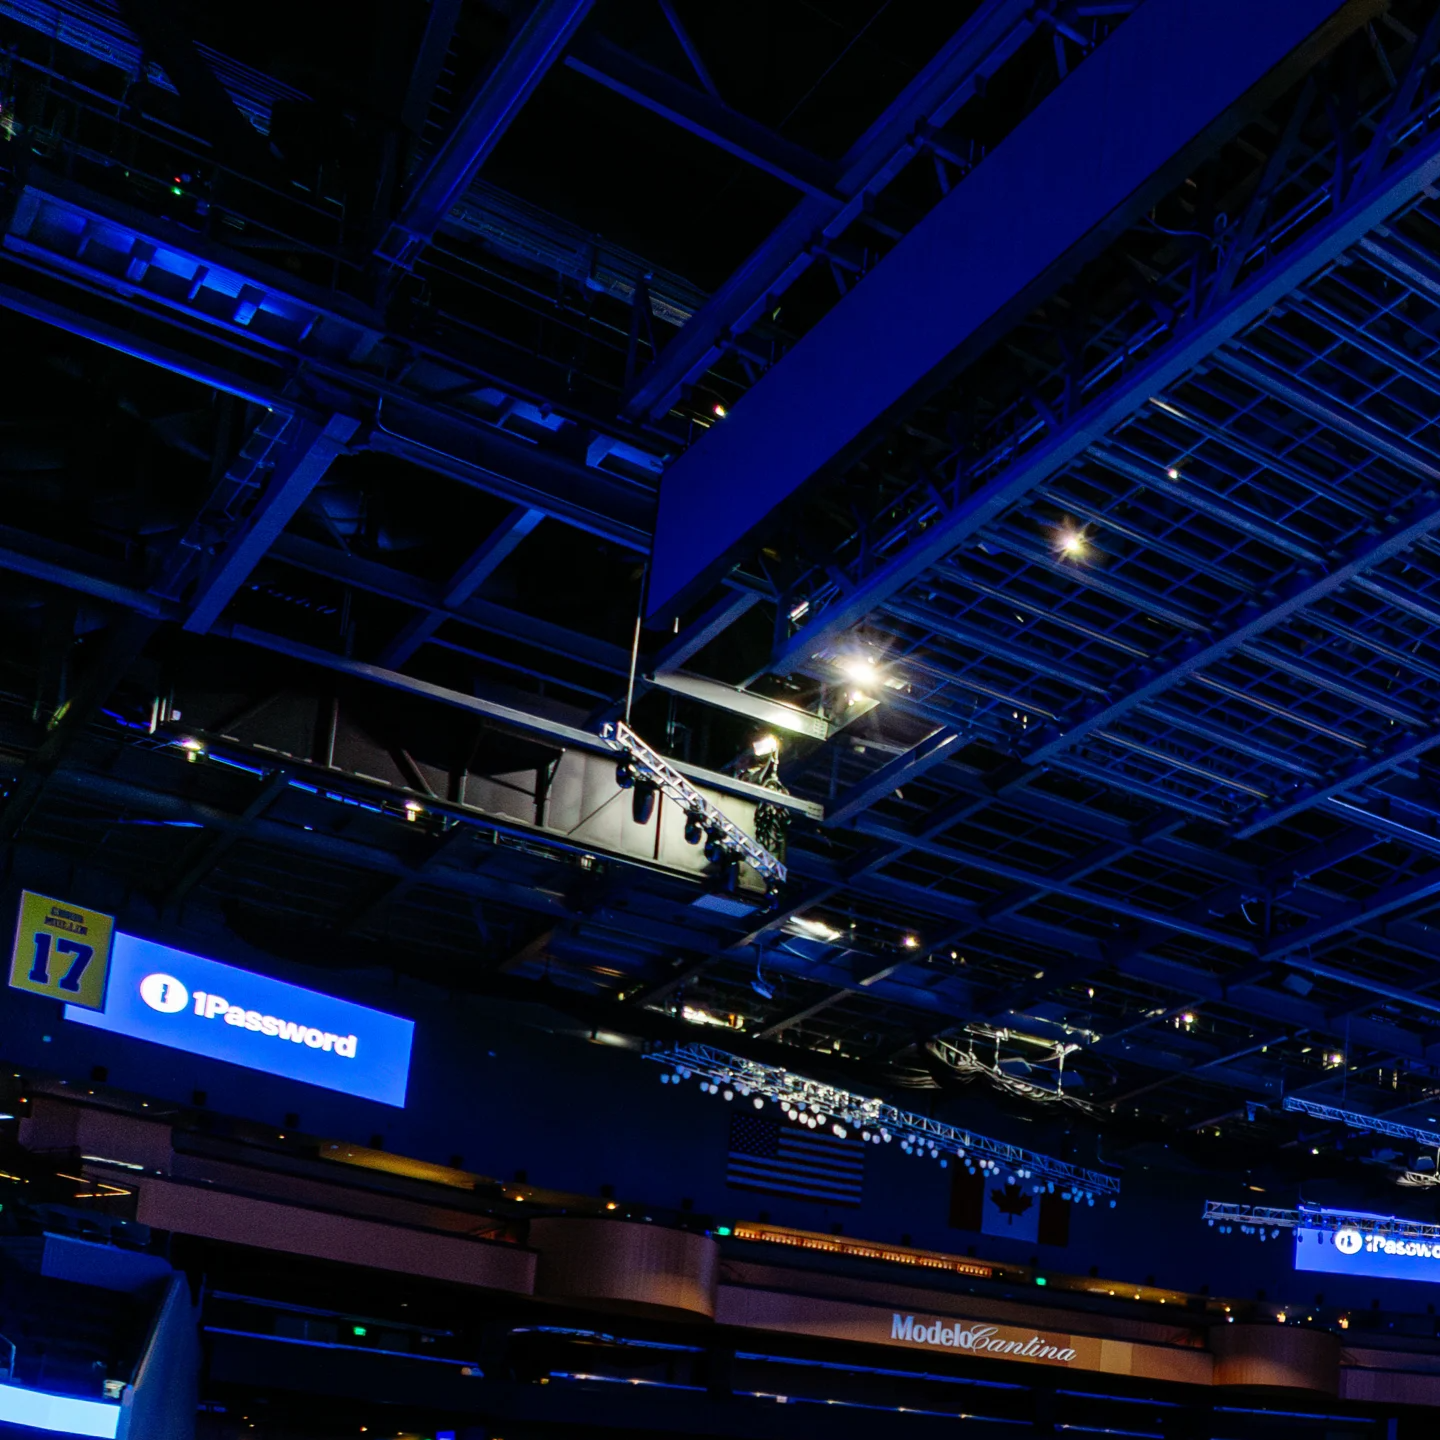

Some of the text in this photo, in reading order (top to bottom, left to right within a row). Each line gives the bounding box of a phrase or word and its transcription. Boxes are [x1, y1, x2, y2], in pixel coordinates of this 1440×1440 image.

[28, 931, 94, 993] 17
[192, 990, 358, 1059] 1Password
[890, 1313, 1077, 1362] Modelo Cantina
